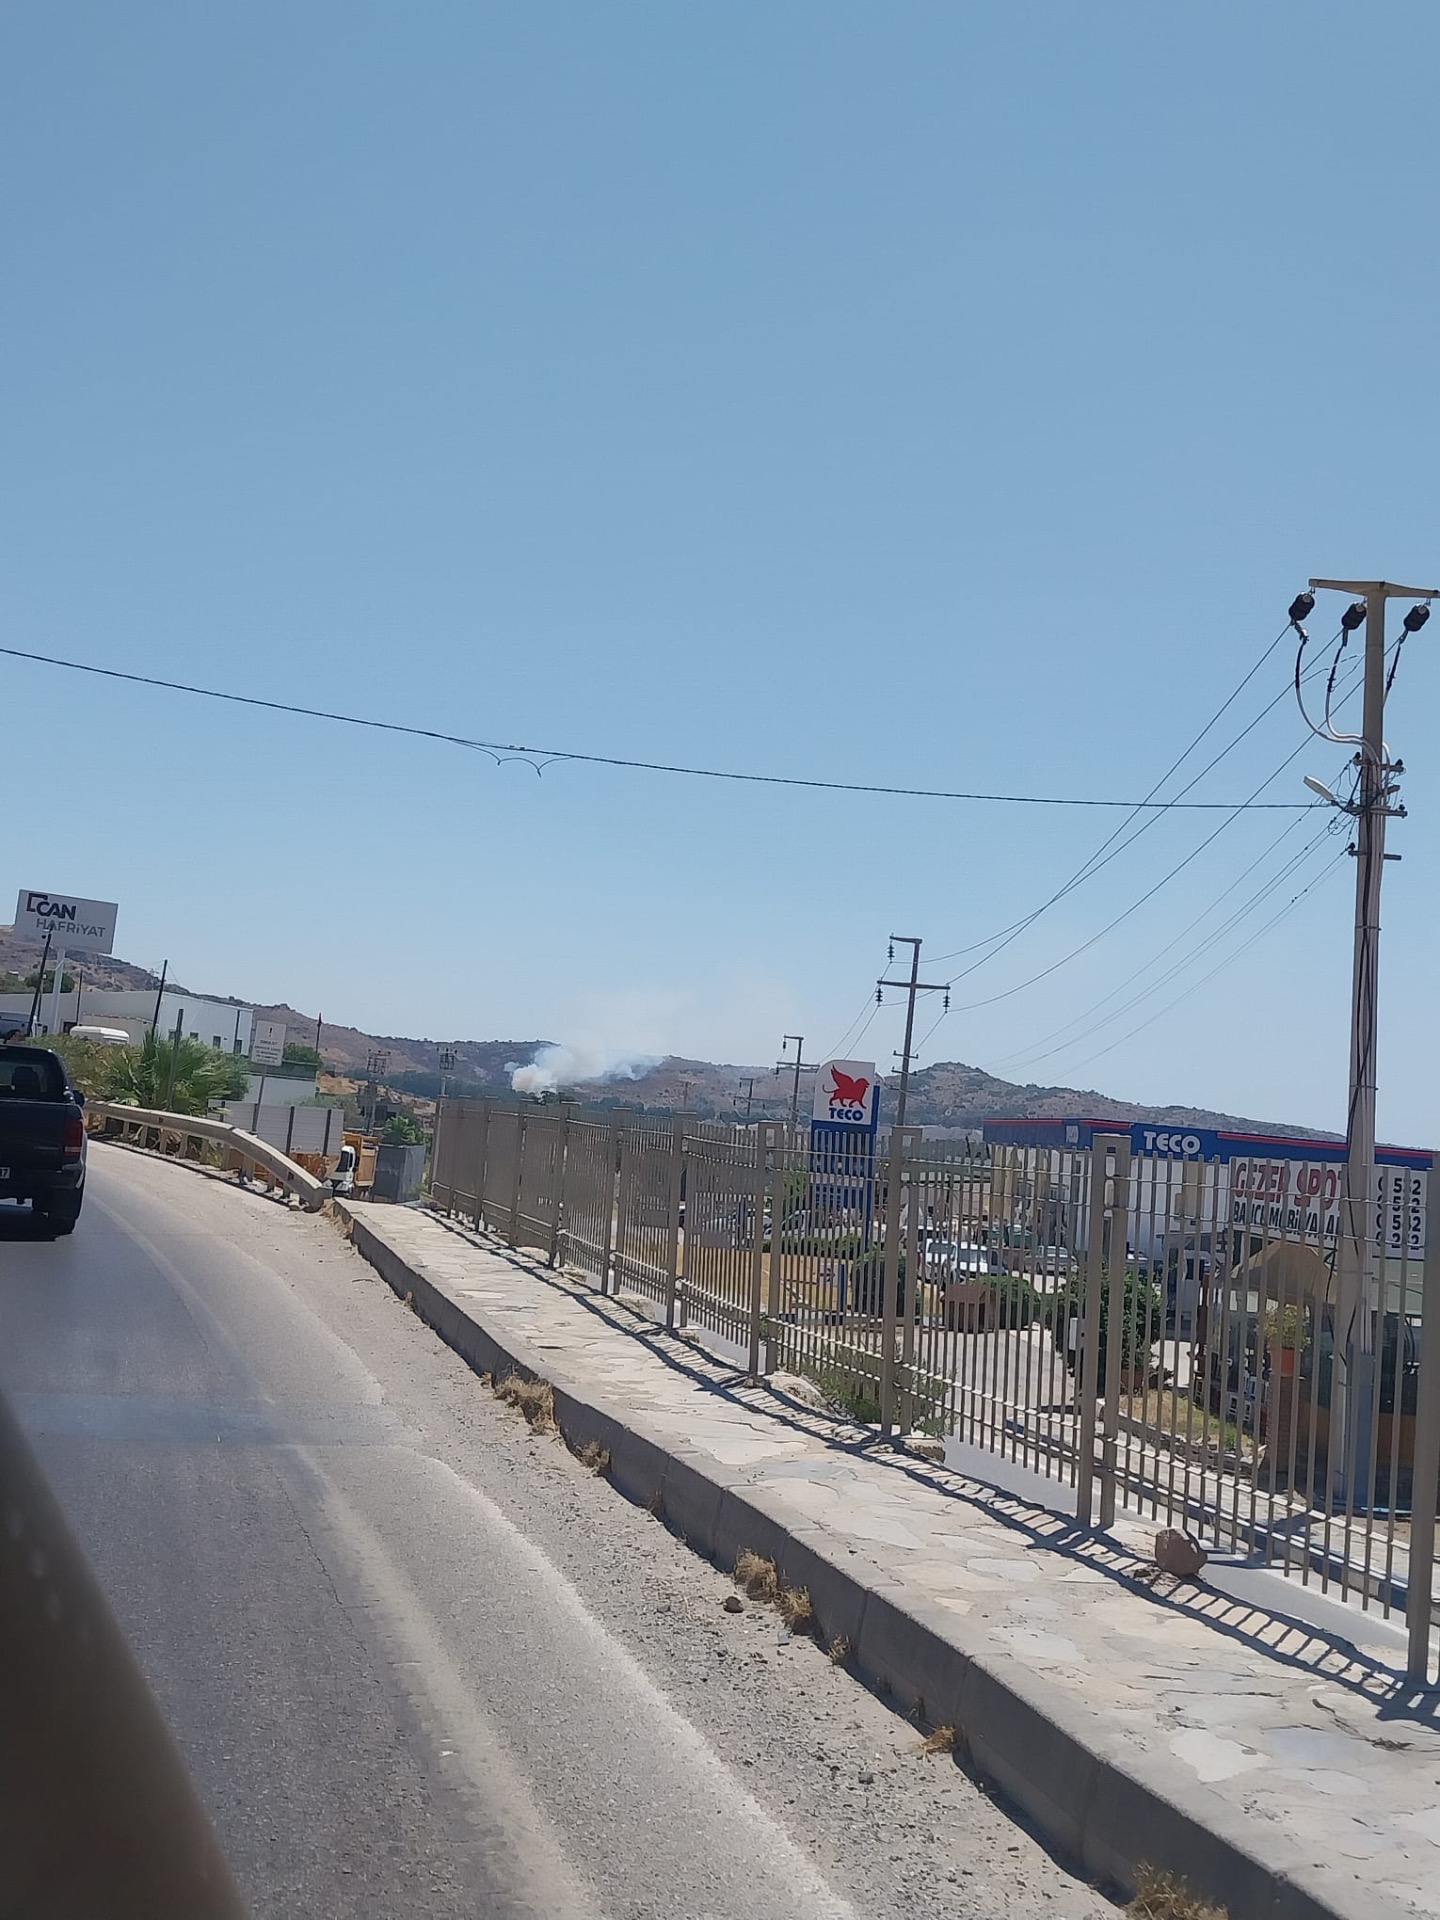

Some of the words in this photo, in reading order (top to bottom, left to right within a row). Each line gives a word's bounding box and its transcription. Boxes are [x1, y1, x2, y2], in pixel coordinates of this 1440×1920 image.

[36, 901, 77, 921] CAN
[829, 1107, 864, 1122] TECO
[1143, 1131, 1201, 1155] TECO
